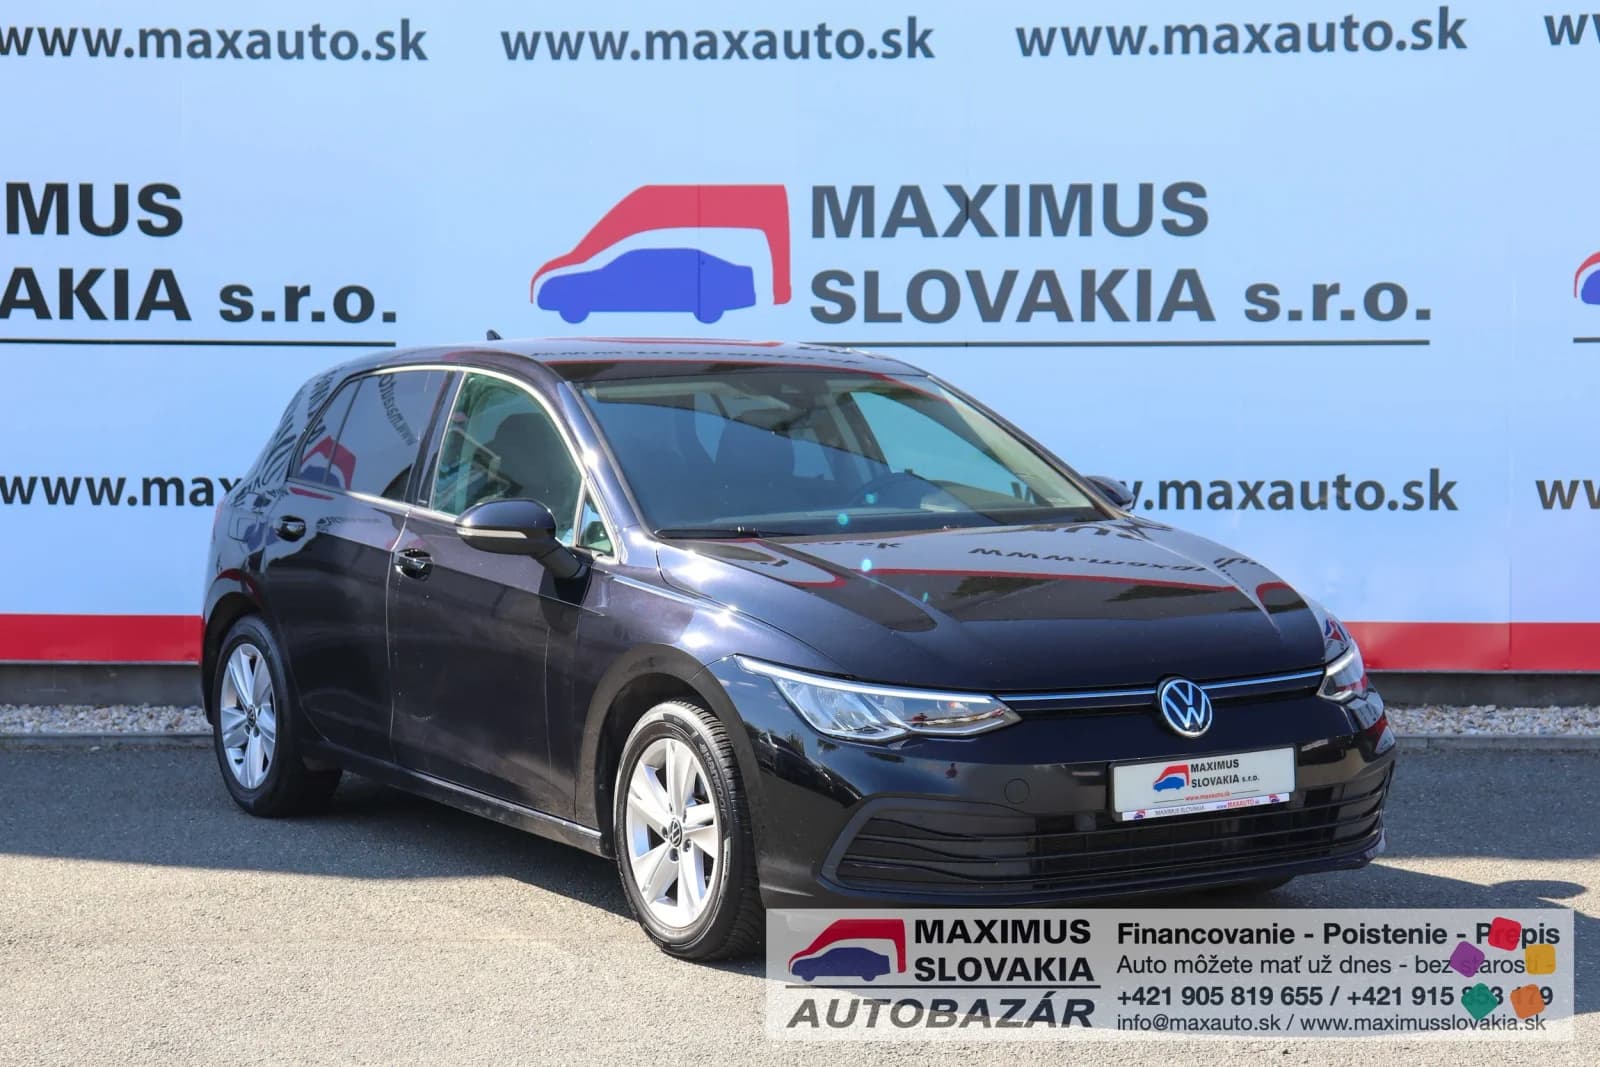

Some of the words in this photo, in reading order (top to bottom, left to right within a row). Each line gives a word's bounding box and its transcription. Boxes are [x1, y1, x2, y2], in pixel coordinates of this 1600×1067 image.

[0, 18, 428, 61] www.maxauto.sk
[501, 15, 935, 61] www.maxauto.sk
[1015, 6, 1468, 57] www.maxauto.sk
[1543, 13, 1600, 46] w
[6, 181, 183, 238] MUS
[812, 181, 1209, 239] MAXIMUS
[0, 267, 193, 322] AKIA
[219, 284, 397, 324] s.r.o.
[810, 268, 1217, 325] SLOVAKIA
[1244, 282, 1431, 323] s.r.o.
[1191, 759, 1240, 773] MAXIMUS
[1191, 773, 1240, 788] SLOVAKIA
